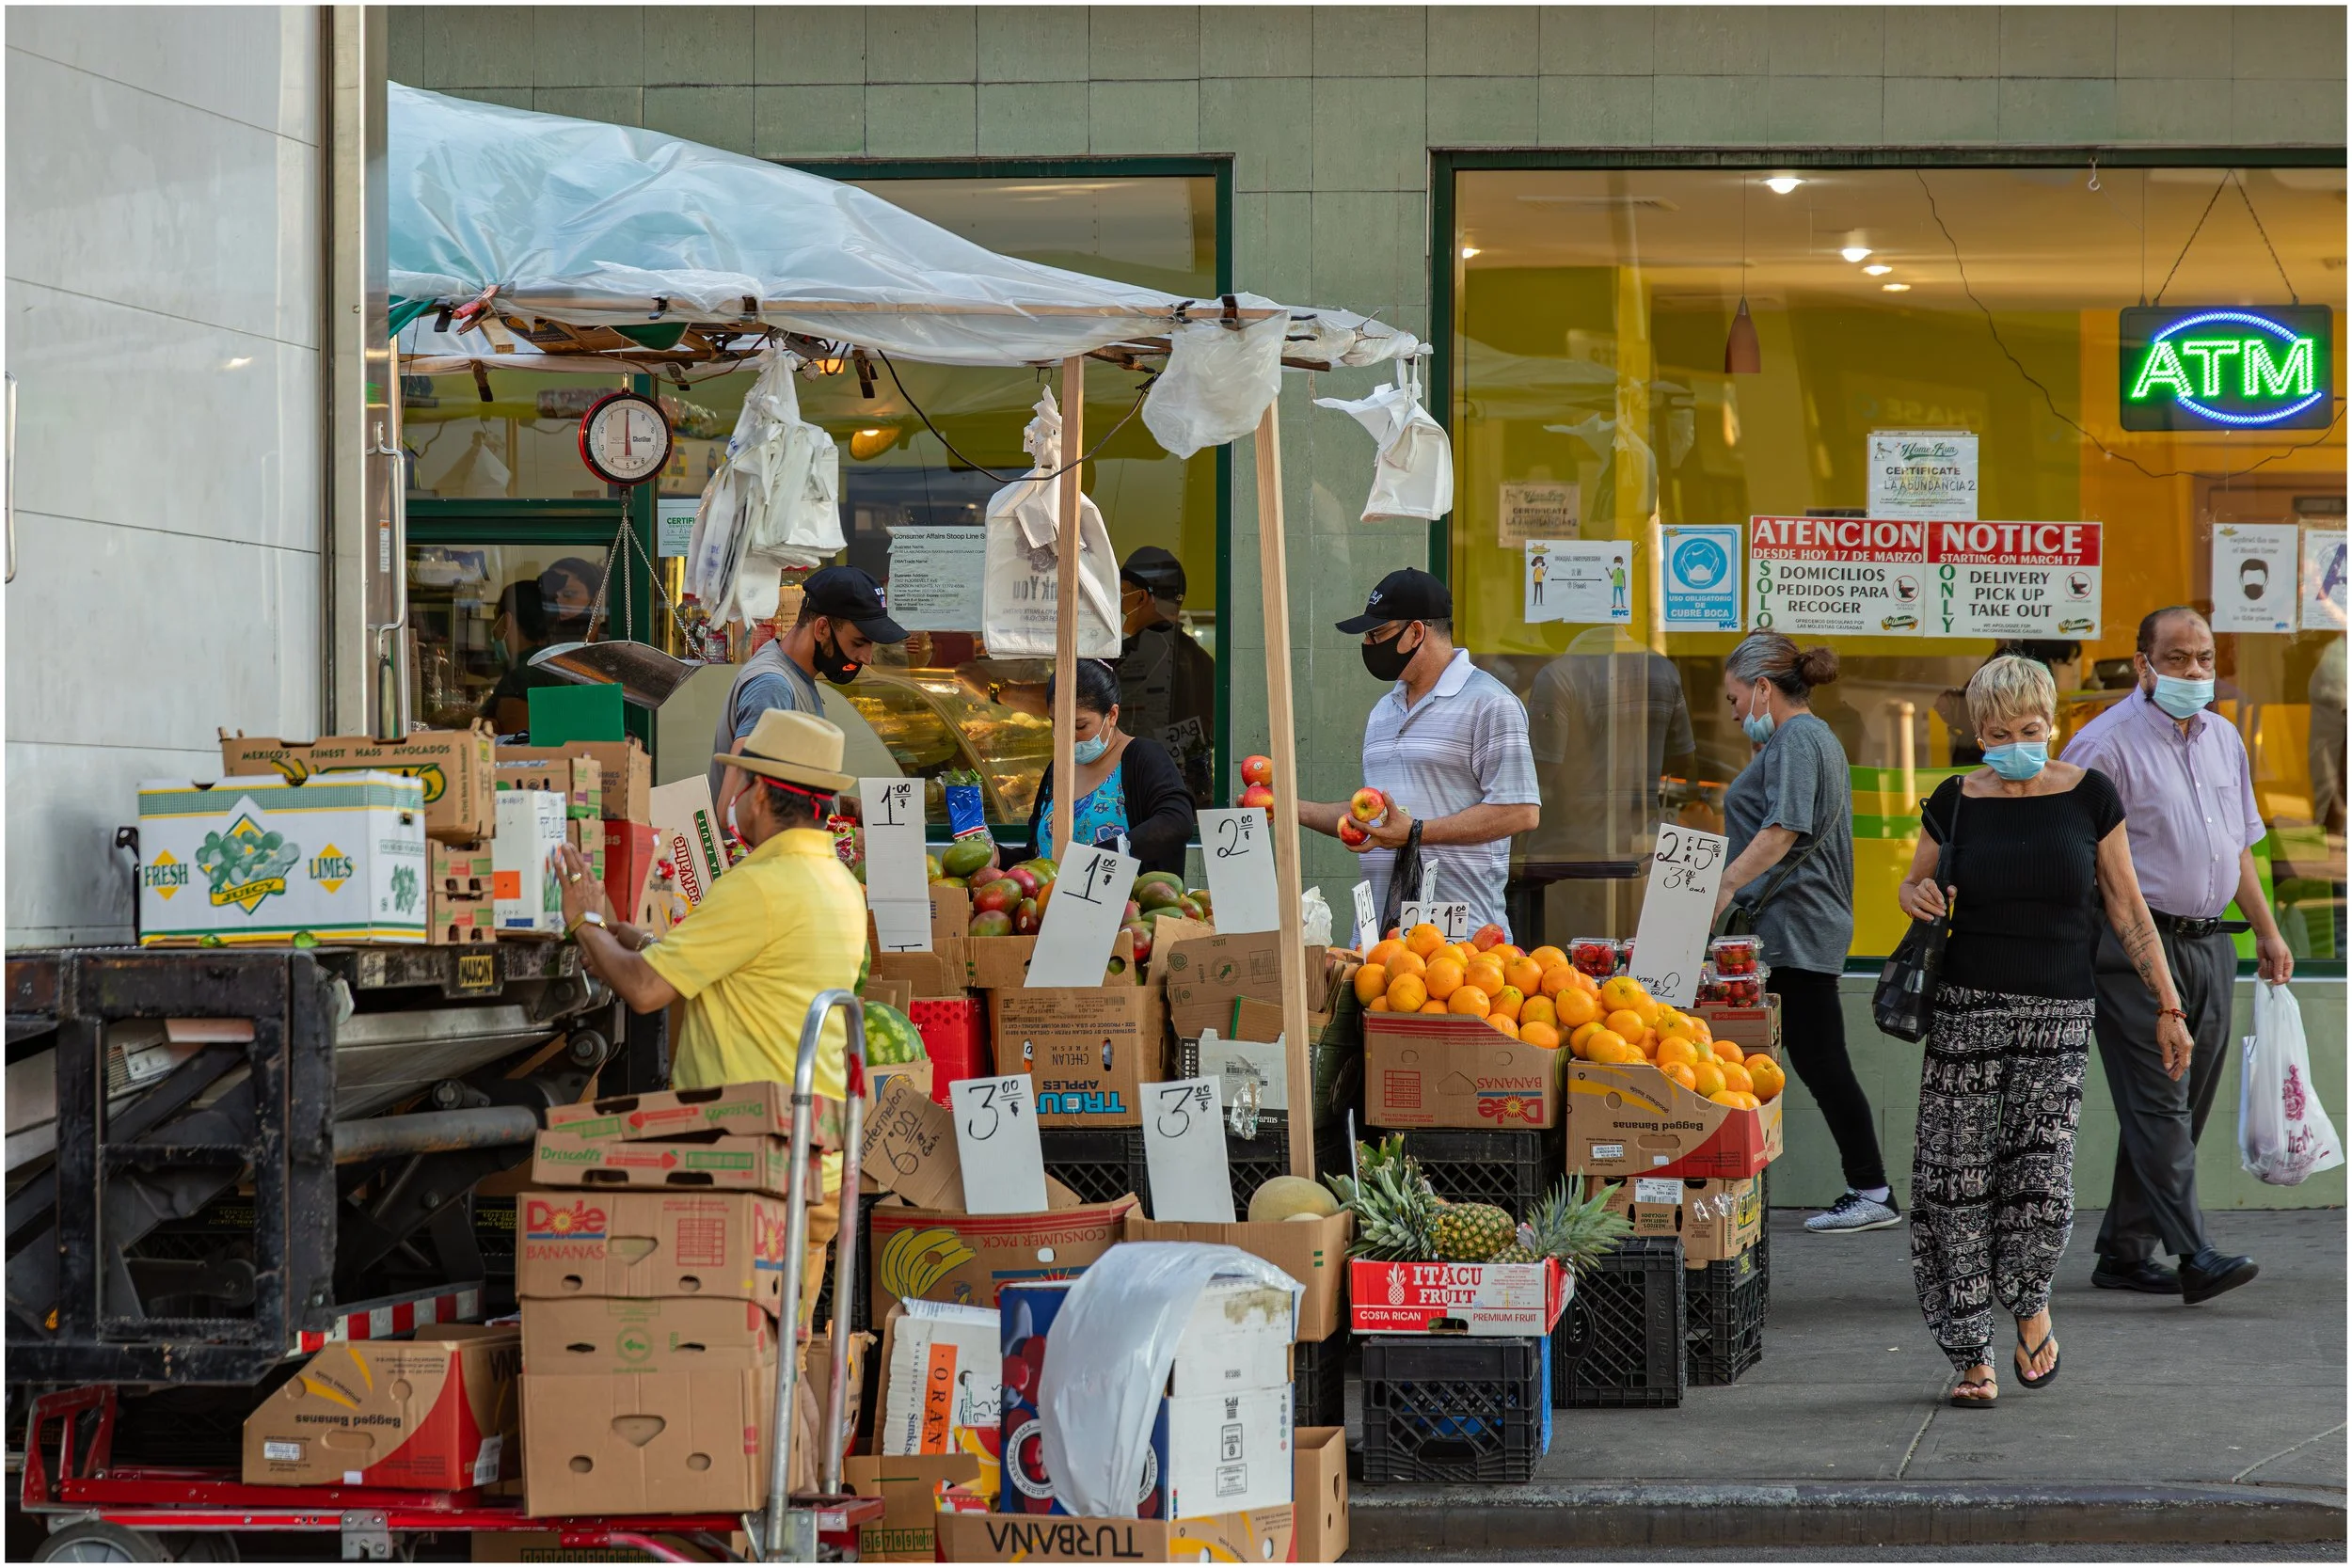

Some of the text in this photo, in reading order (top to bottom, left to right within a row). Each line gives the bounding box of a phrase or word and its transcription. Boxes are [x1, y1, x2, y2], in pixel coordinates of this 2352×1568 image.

[2131, 339, 2313, 398] ATM
[1901, 442, 1958, 457] Home Run
[1885, 467, 1962, 475] CERTIFICATE
[1884, 481, 1898, 490] LA
[1967, 480, 1977, 491] 2
[1754, 519, 1921, 548] ATENCION
[1942, 523, 2083, 554] NOTICE
[1753, 548, 1923, 563] DESDE HOY 17 DE MARZO
[1940, 554, 2080, 565] STARTING ON MARCH 17
[1780, 566, 1885, 581] DOMICILIOS
[1970, 571, 2051, 585] DELIVERY
[1756, 560, 1773, 628] SOLO
[1776, 584, 1889, 598] PEDIDOS PARA
[1939, 564, 1956, 633] ONLY
[1976, 588, 2044, 601] PICK UP
[1705, 610, 1729, 618] BOCA
[1788, 600, 1862, 613] RECOGER
[1969, 604, 2053, 617] TAKE OUT
[242, 744, 451, 761] MEXICO'S FINEST HASS AVOCADOS
[698, 816, 713, 855] FRUIT
[1656, 832, 1681, 863] 2
[1683, 836, 1693, 863] FOR
[144, 863, 189, 887] FRESH
[309, 856, 353, 880] LIMES
[673, 835, 702, 906] eetValue
[221, 879, 276, 904] JUICY
[1052, 1053, 1089, 1066] CHELAN
[1043, 1080, 1099, 1089] APPLES
[1477, 1076, 1543, 1089] BANANAS
[1035, 1091, 1126, 1114] TROU
[1477, 1095, 1544, 1124] Dole
[1613, 1120, 1704, 1132] Bagged Bananas
[541, 1146, 602, 1164] Driscoll's
[527, 1200, 607, 1232] Dole
[982, 1227, 1106, 1248] CONSUMER PACK
[526, 1245, 605, 1260] BANANAS
[1413, 1265, 1483, 1286] ITACU
[1420, 1289, 1476, 1304] FRUIT
[1359, 1310, 1422, 1322] COSTA RICAN
[1472, 1313, 1537, 1323] PREMIUM FRUIT
[926, 1367, 949, 1446] ORAN
[295, 1413, 402, 1428] Bagged Bananas
[904, 1413, 918, 1455] Sunkis
[986, 1521, 1144, 1559] TURBANA
